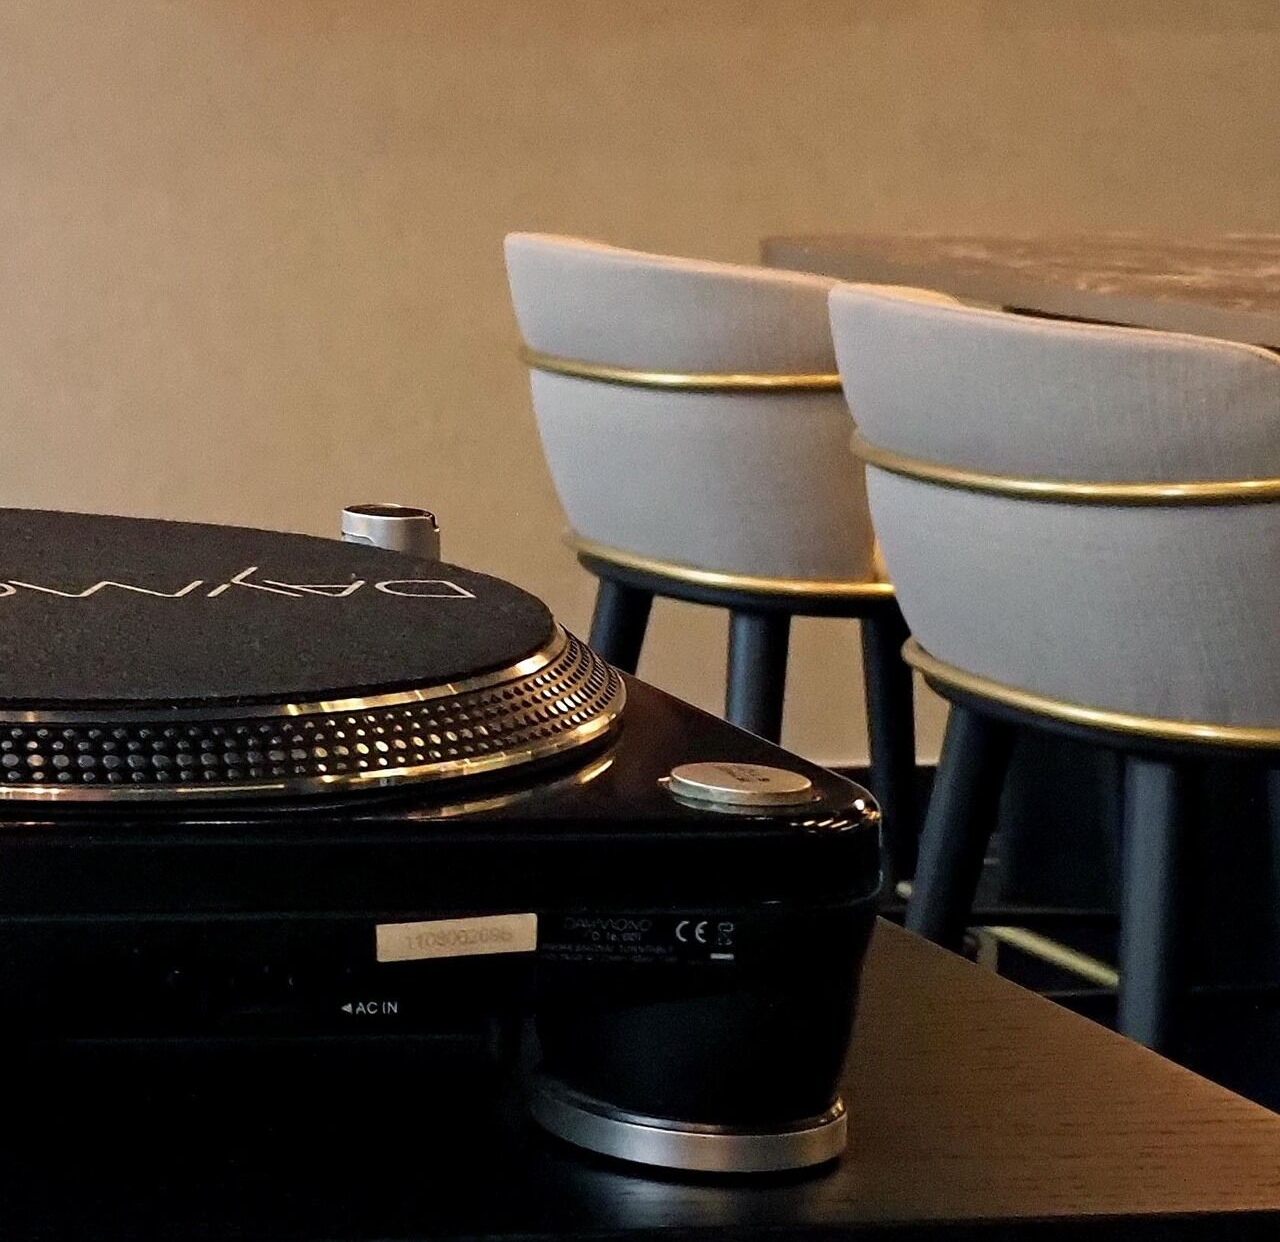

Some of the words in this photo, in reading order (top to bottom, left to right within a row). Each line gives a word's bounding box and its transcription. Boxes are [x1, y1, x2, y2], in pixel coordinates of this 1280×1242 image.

[675, 920, 708, 943] CE
[355, 1001, 378, 1015] AC
[382, 1001, 398, 1015] IN
